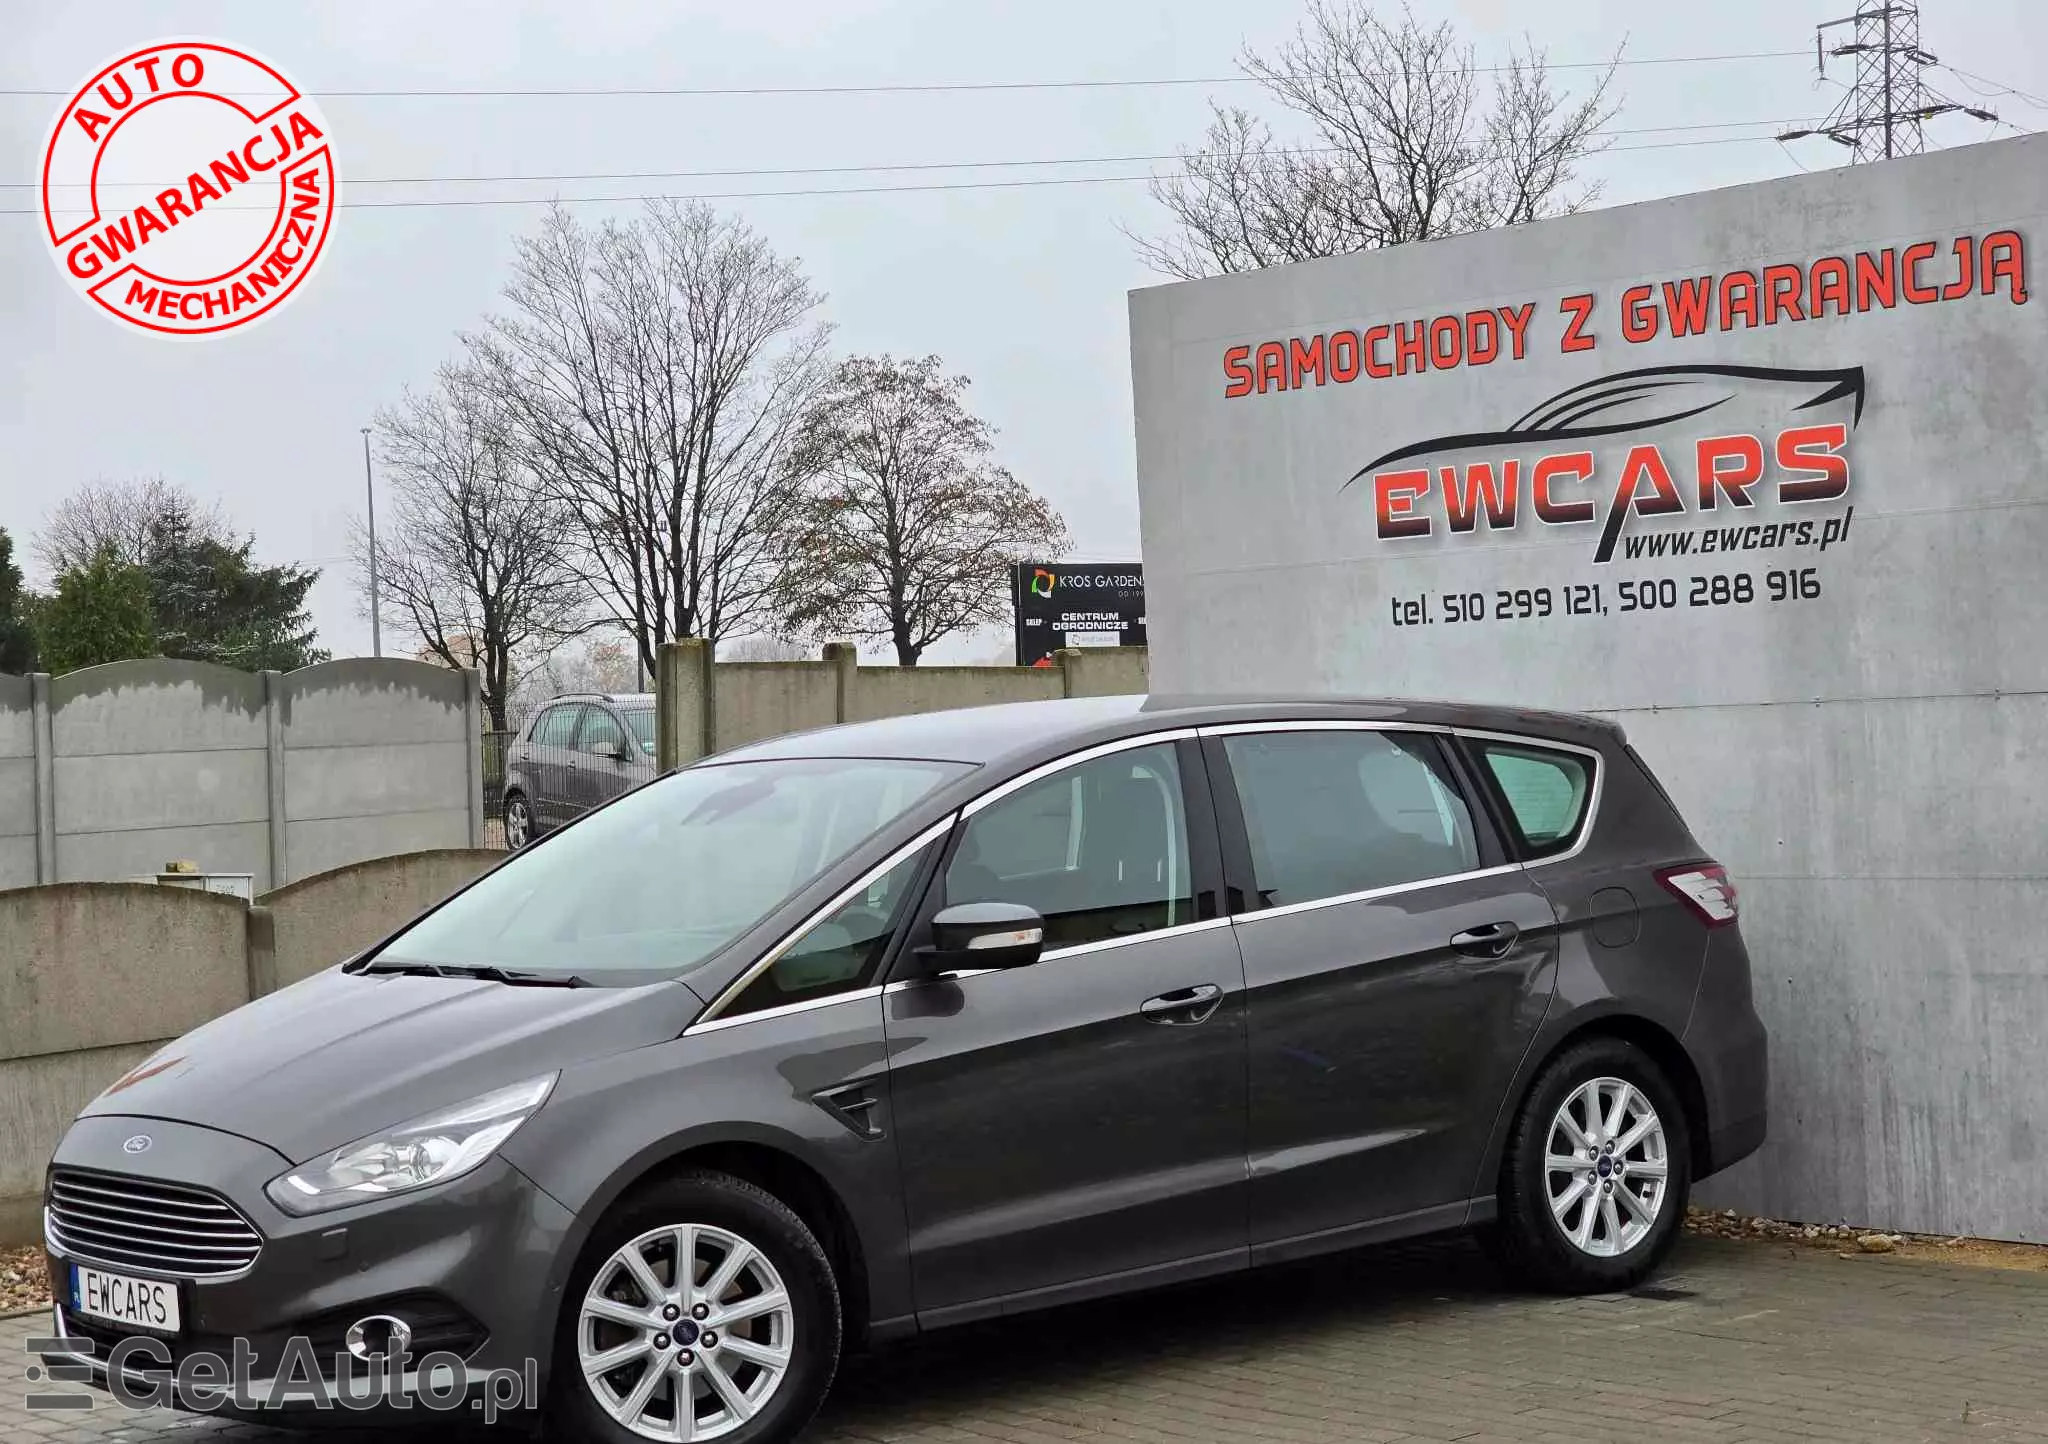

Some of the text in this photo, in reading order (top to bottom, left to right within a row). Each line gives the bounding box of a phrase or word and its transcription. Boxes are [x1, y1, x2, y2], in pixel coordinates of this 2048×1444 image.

[1223, 229, 2029, 399] SAMOCHODY Z GWARANCJĄ
[1373, 423, 1850, 564] EWCARS
[1624, 506, 1854, 560] www.ewcars.pl
[1059, 575, 1144, 588] KROS GARDEN
[1132, 590, 1144, 598] 199
[1391, 567, 1822, 626] tel. 510 299 121, 500 288 916
[1052, 621, 1129, 631] OGRODNICZE
[1061, 612, 1119, 621] CENTRUM
[87, 1272, 167, 1324] EWCARS
